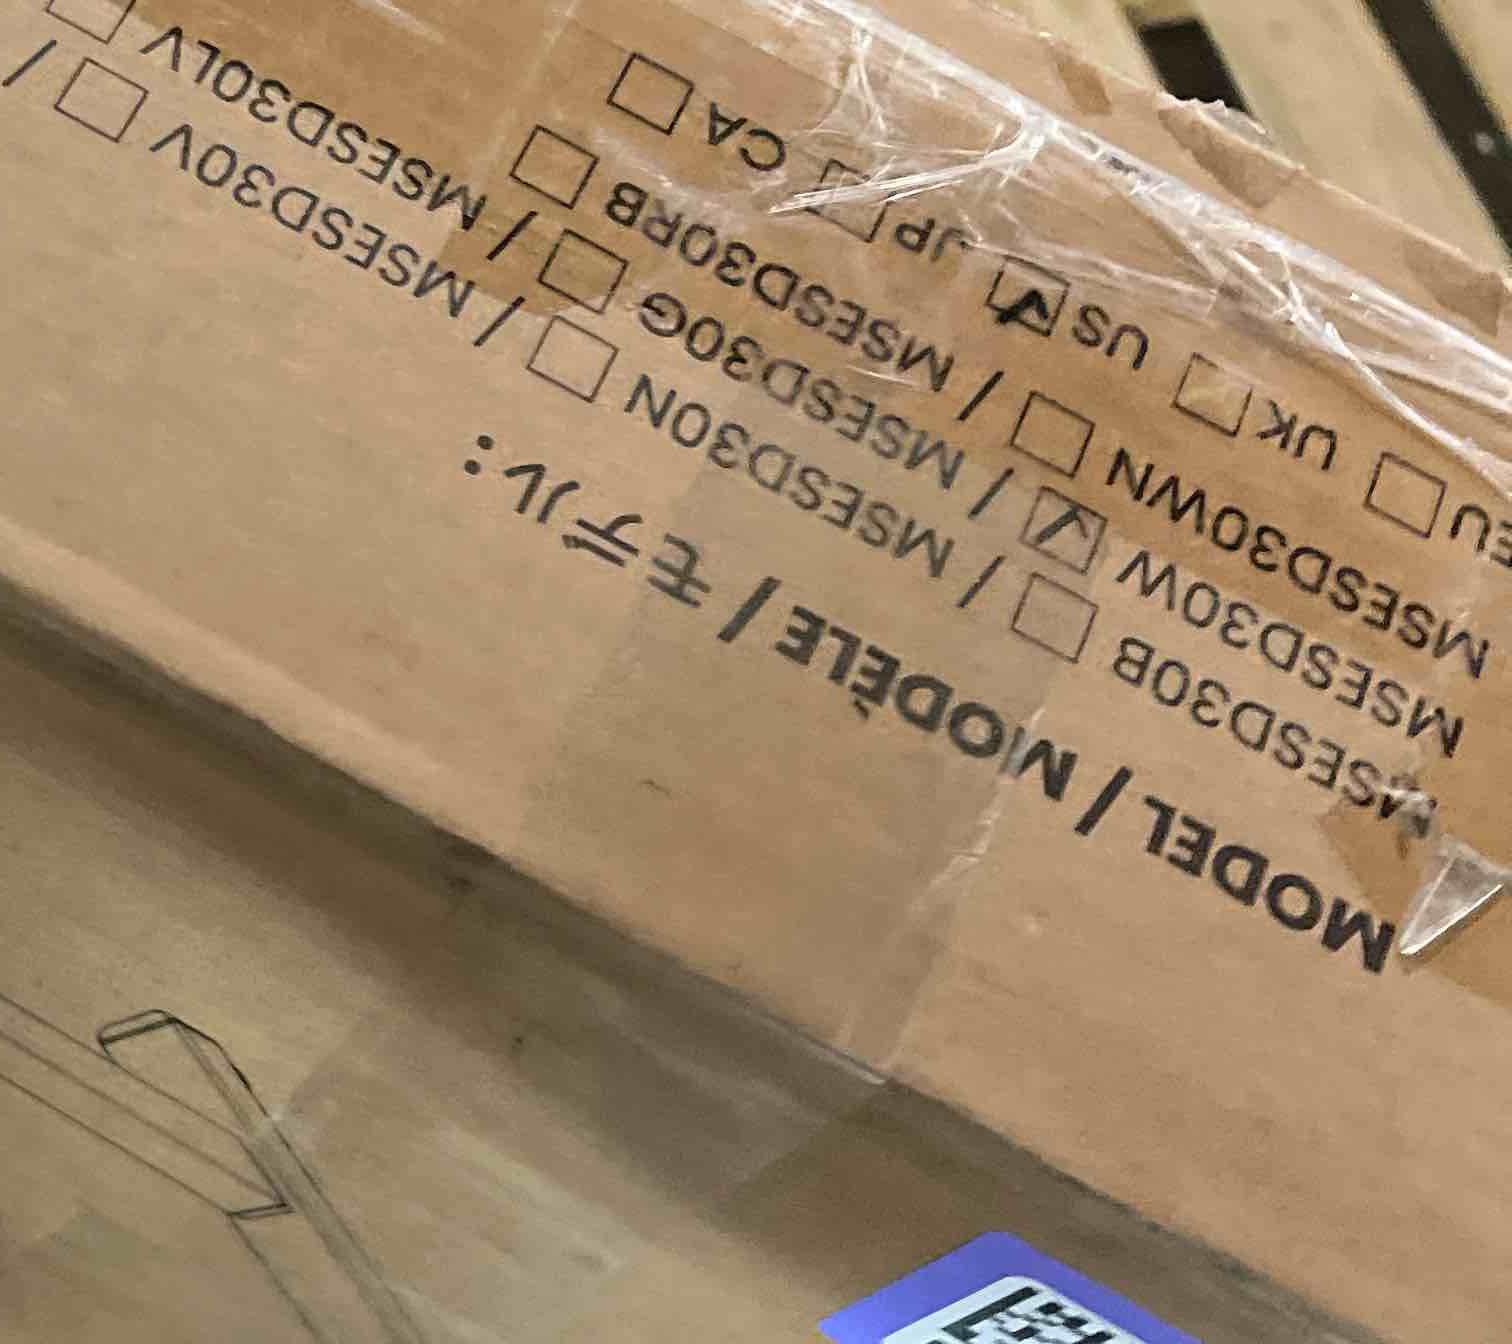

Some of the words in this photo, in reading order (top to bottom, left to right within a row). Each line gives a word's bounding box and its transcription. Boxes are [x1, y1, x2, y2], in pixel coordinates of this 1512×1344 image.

[139, 25, 487, 231] MSESD30LV
[149, 123, 476, 319] MSESD30V
[705, 102, 788, 172] CA
[604, 181, 954, 393] MSESD30RB
[895, 218, 970, 264] JP
[1071, 304, 1149, 370] US
[624, 373, 956, 580] MSESD30N
[637, 291, 965, 489] MSESD30G
[1256, 398, 1338, 472] UK
[1105, 447, 1490, 680] MSESD30WN
[1115, 550, 1465, 759] MSESD30W
[776, 605, 1078, 803] MODÈLE
[1112, 636, 1438, 839] MSESD30B
[1143, 794, 1396, 975] MODEL
